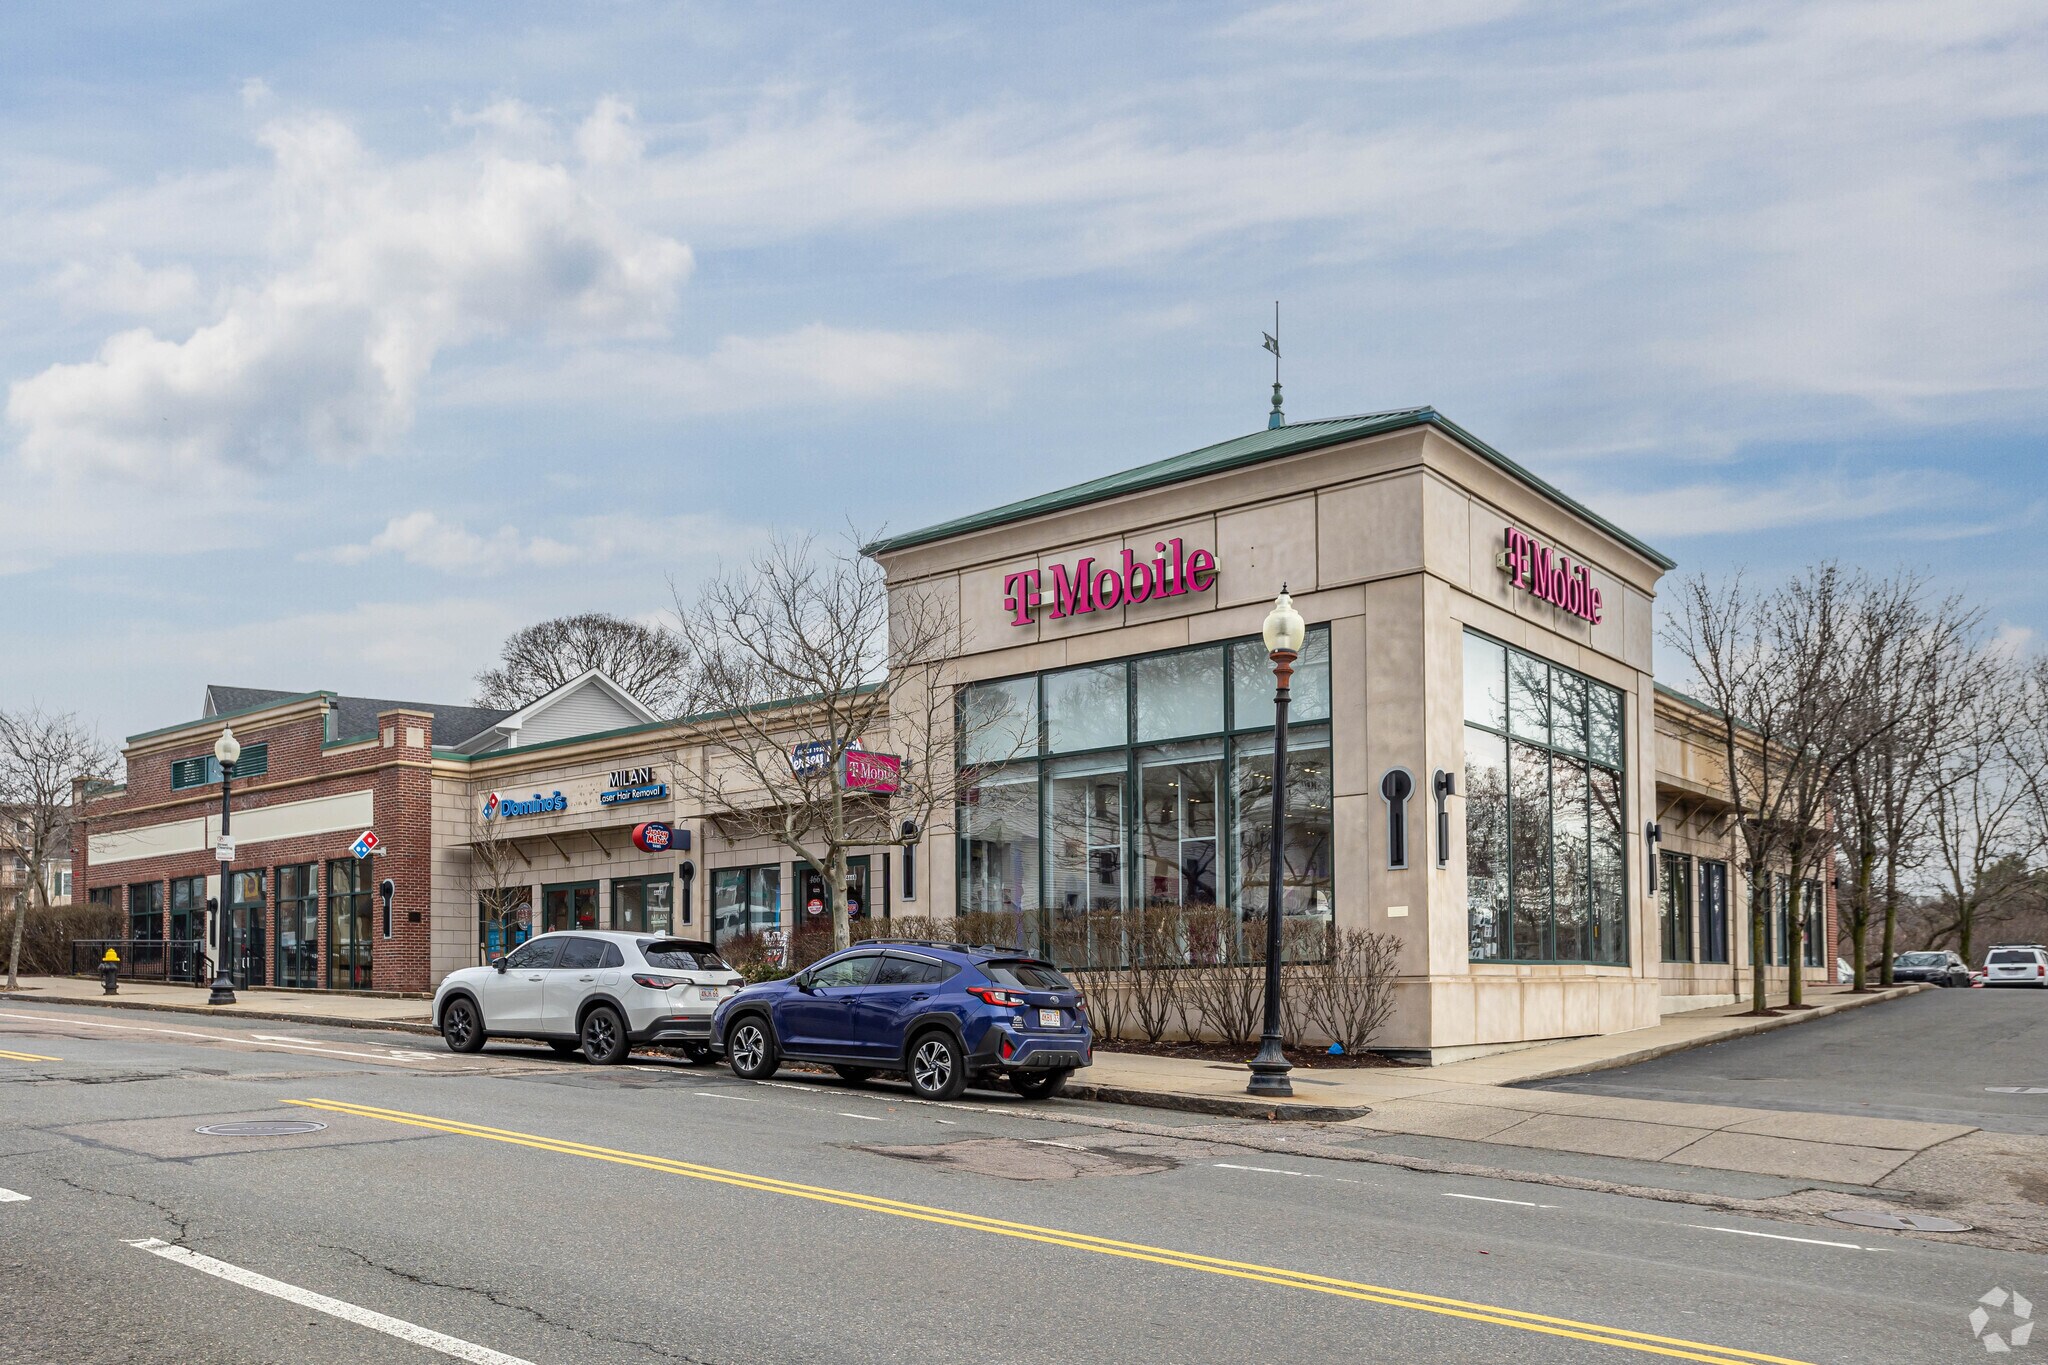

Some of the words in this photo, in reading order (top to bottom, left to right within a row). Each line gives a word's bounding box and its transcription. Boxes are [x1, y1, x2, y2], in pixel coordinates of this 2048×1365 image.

[1048, 538, 1216, 620] Mobile
[1529, 540, 1603, 624] Mobile
[609, 767, 652, 788] MILAN
[500, 791, 568, 817] Domino's
[617, 790, 631, 801] Hair
[632, 786, 660, 799] Removal
